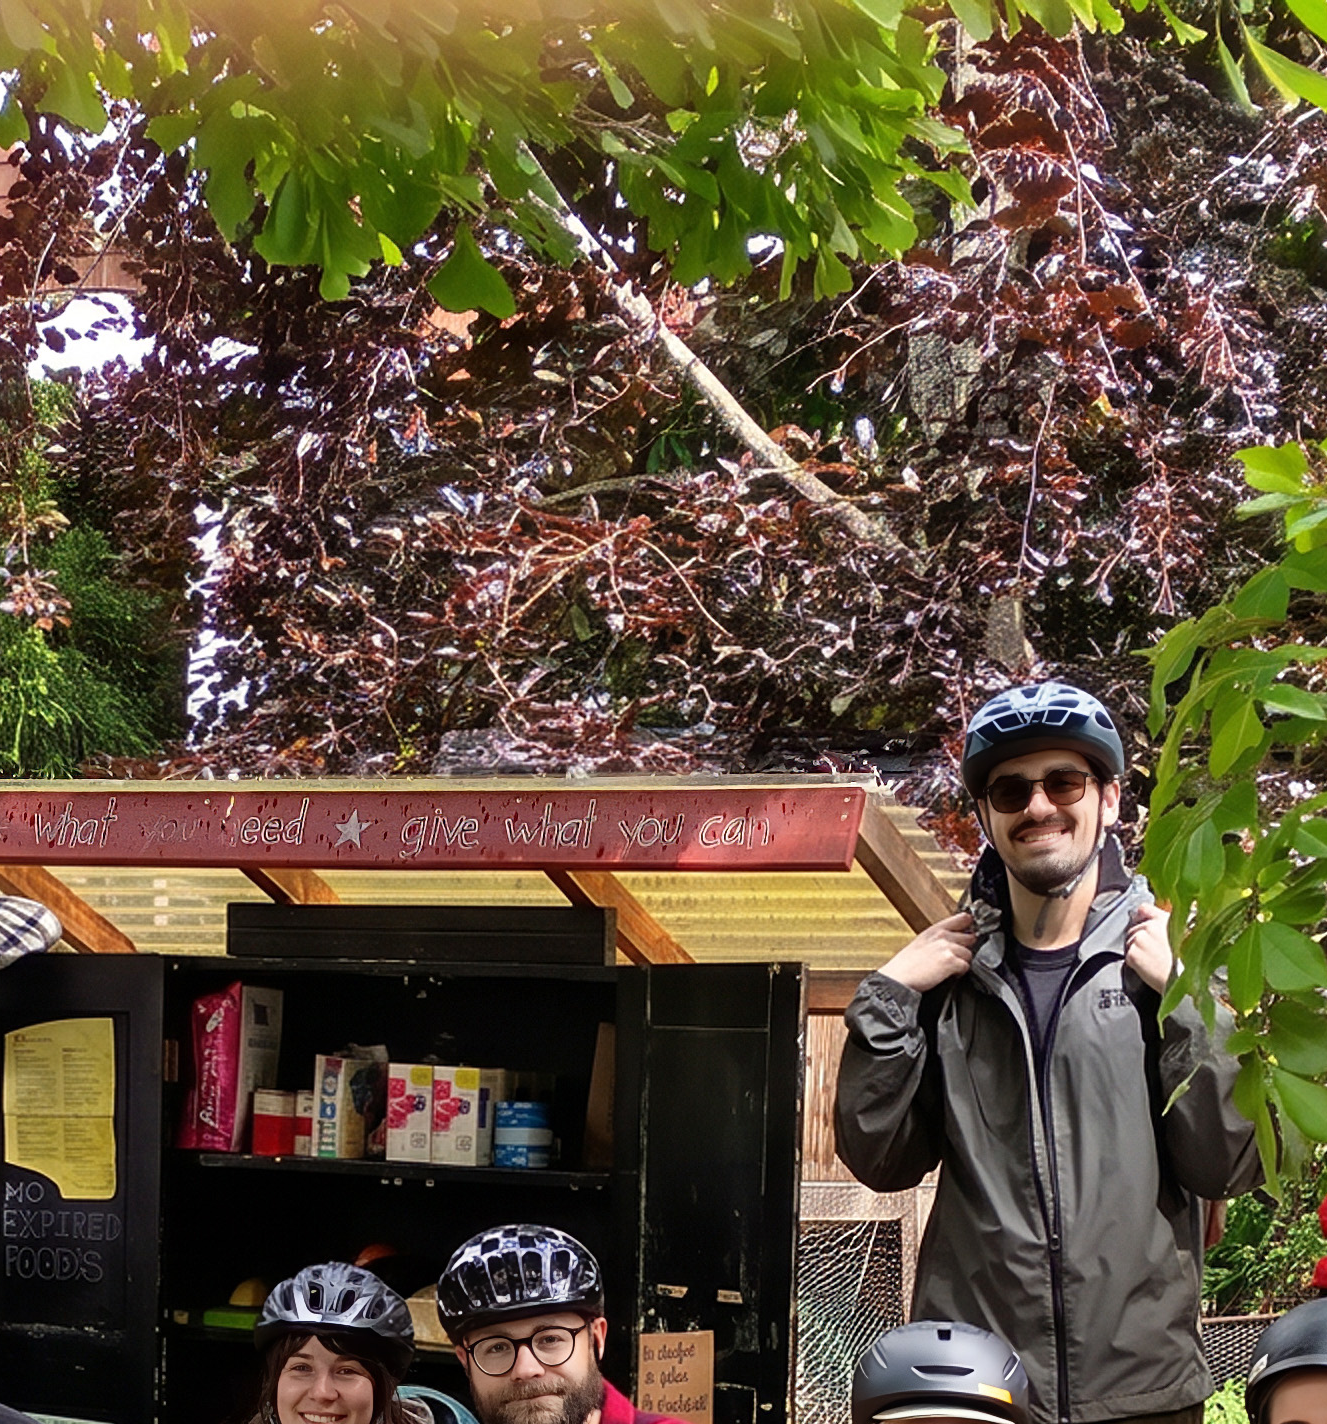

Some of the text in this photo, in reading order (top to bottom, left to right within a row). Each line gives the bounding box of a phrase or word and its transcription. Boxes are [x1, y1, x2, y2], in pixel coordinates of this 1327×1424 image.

[33, 796, 118, 848] what
[399, 808, 480, 858] give
[504, 799, 598, 849] what
[618, 813, 684, 858] you
[698, 813, 771, 850] can
[3, 1210, 123, 1241] EXPIRED
